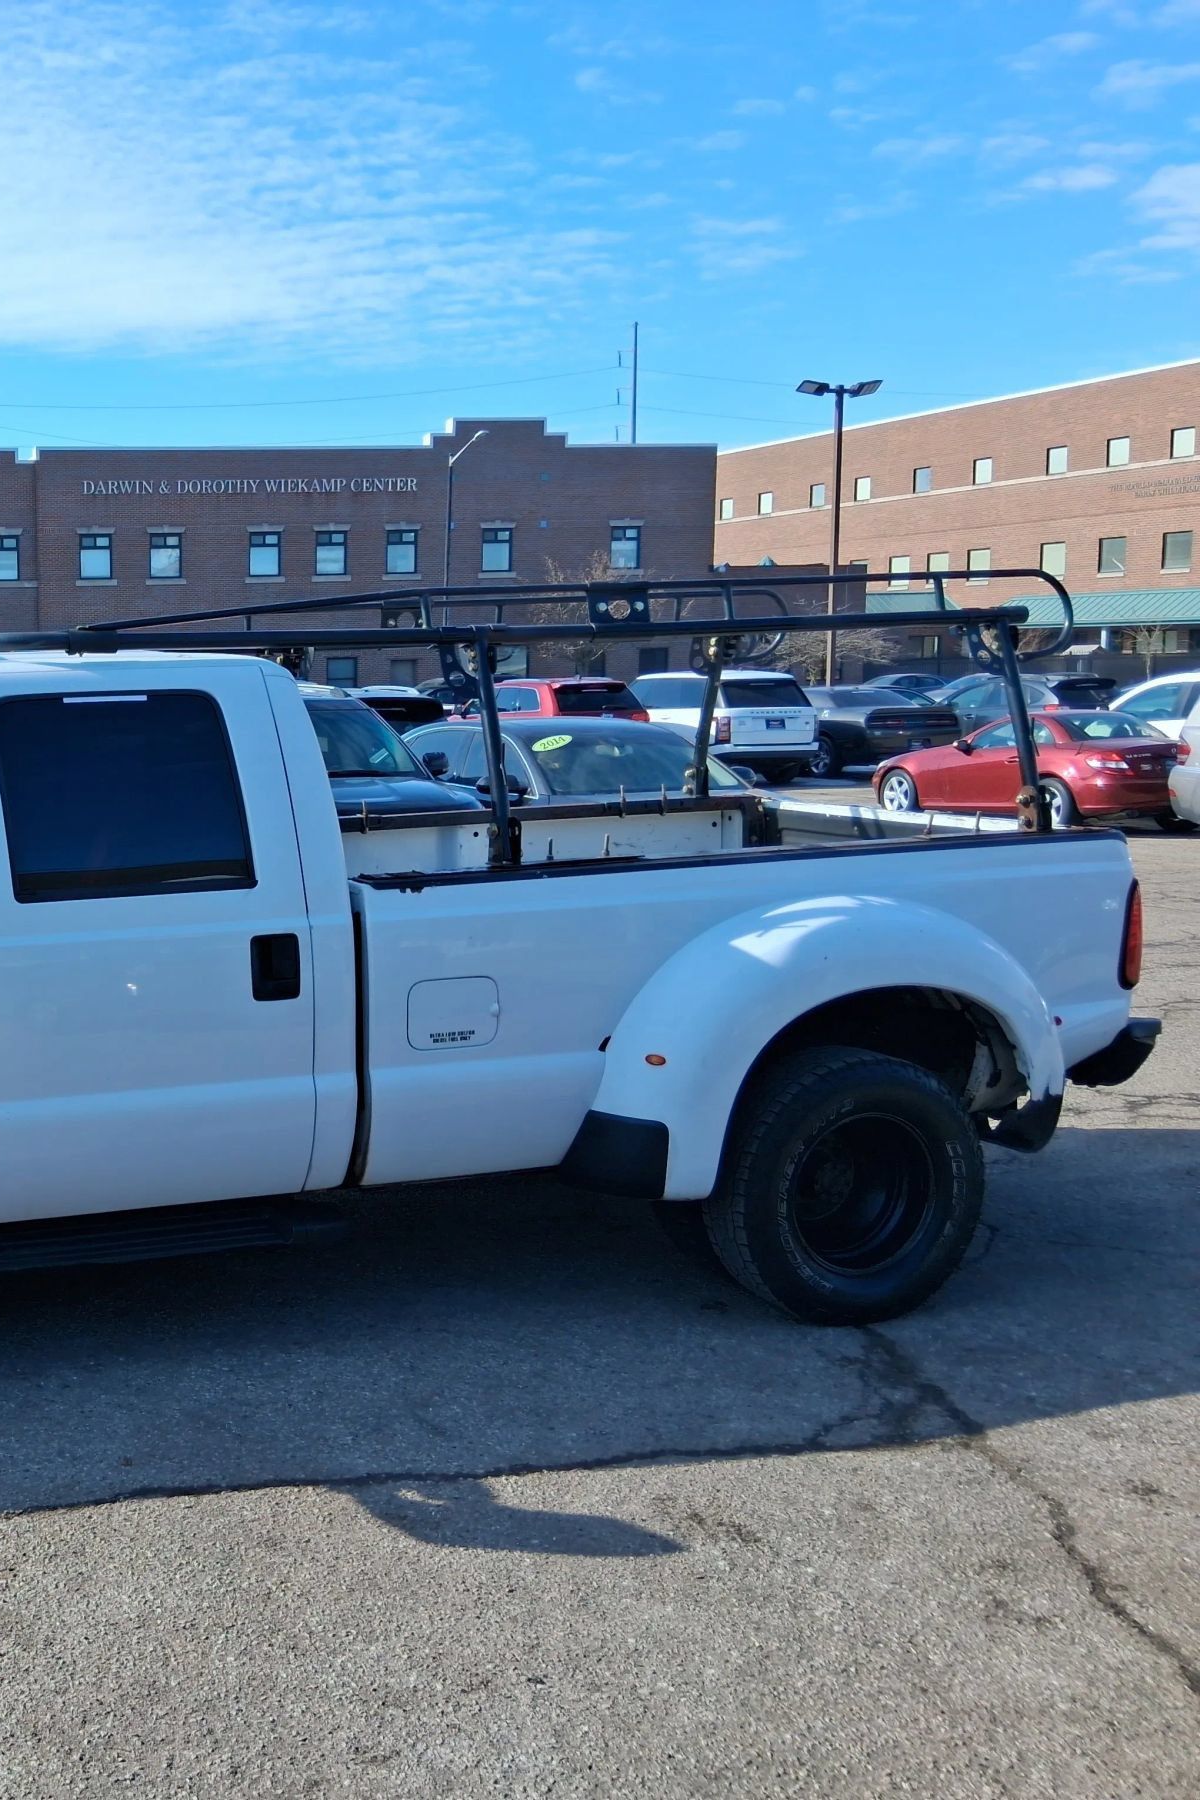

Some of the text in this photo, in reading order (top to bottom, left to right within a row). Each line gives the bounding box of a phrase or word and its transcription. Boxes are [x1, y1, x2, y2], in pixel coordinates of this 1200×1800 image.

[83, 477, 418, 495] DARWIN & DOROTHY WIEKAMP CENTER
